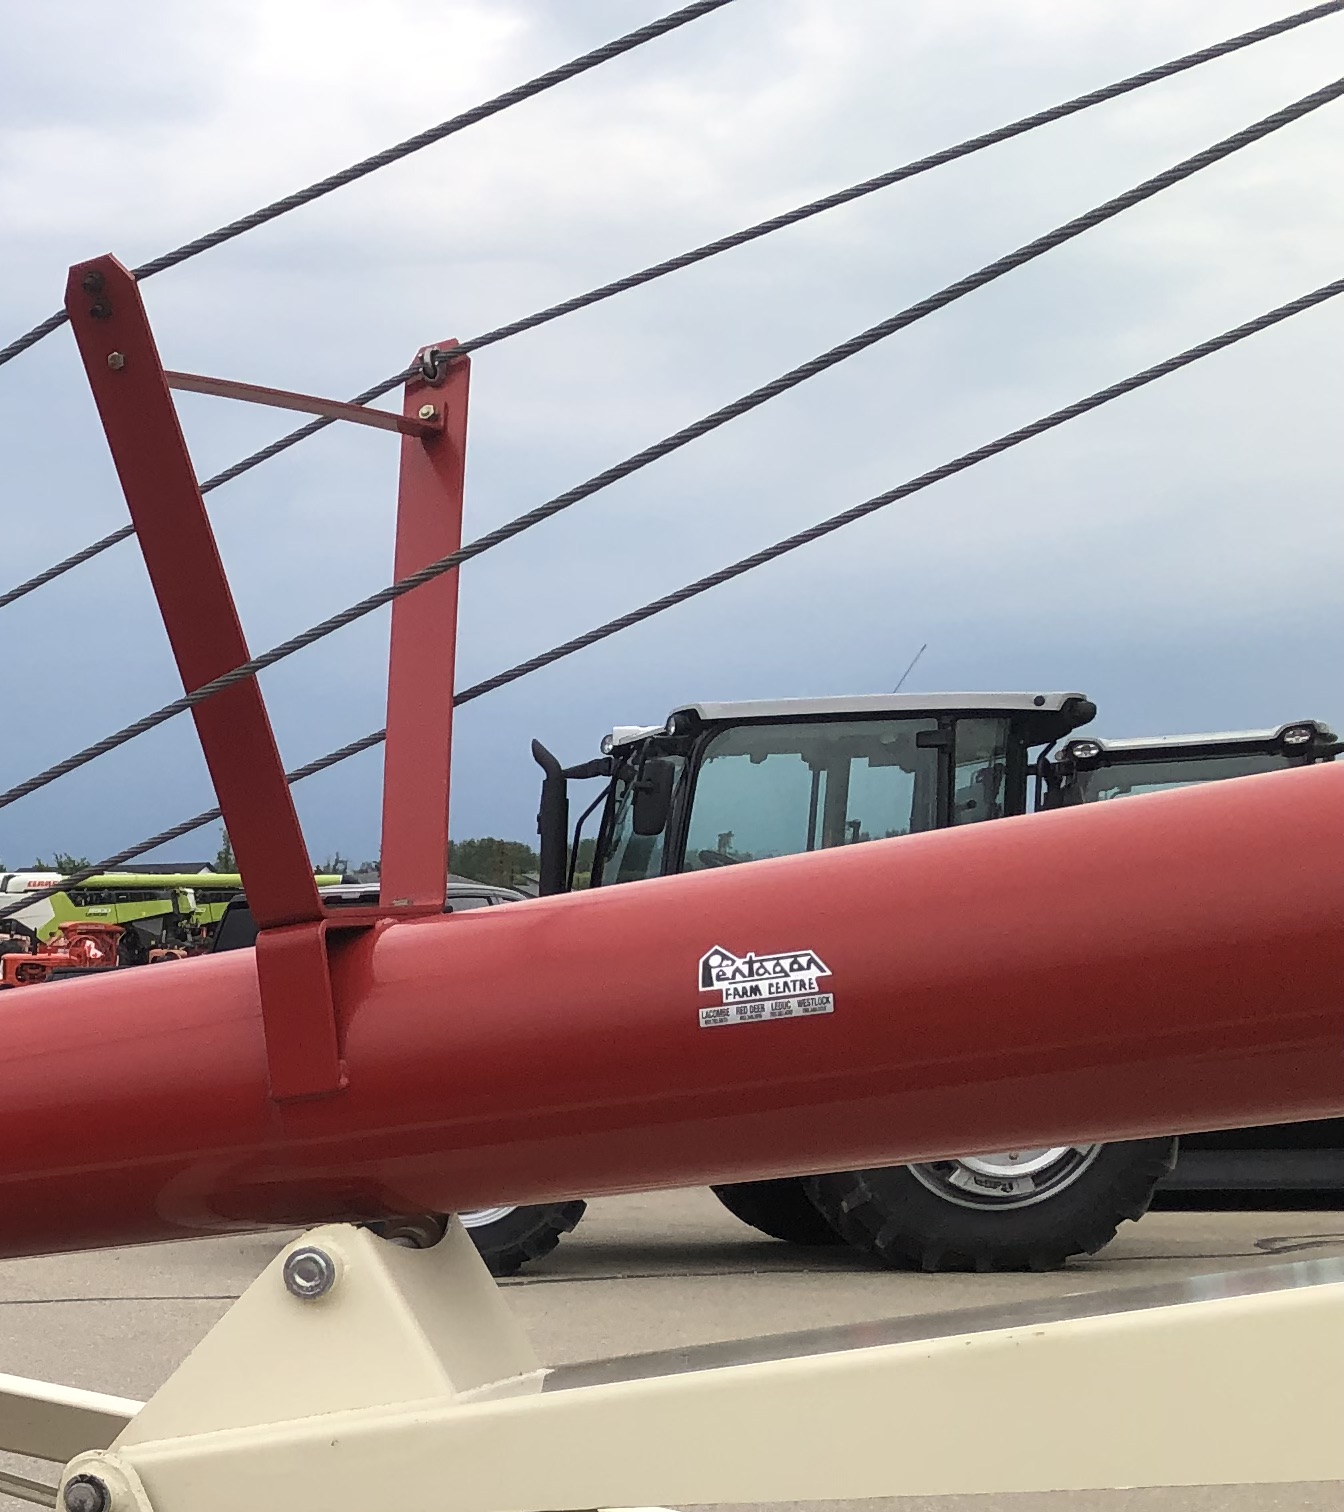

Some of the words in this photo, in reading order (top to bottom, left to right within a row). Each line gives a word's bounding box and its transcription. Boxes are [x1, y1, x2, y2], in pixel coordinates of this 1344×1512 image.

[701, 949, 827, 988] Pentagon
[725, 986, 763, 1000] FARM
[768, 977, 816, 995] CENTRE
[736, 1005, 748, 1015] RED
